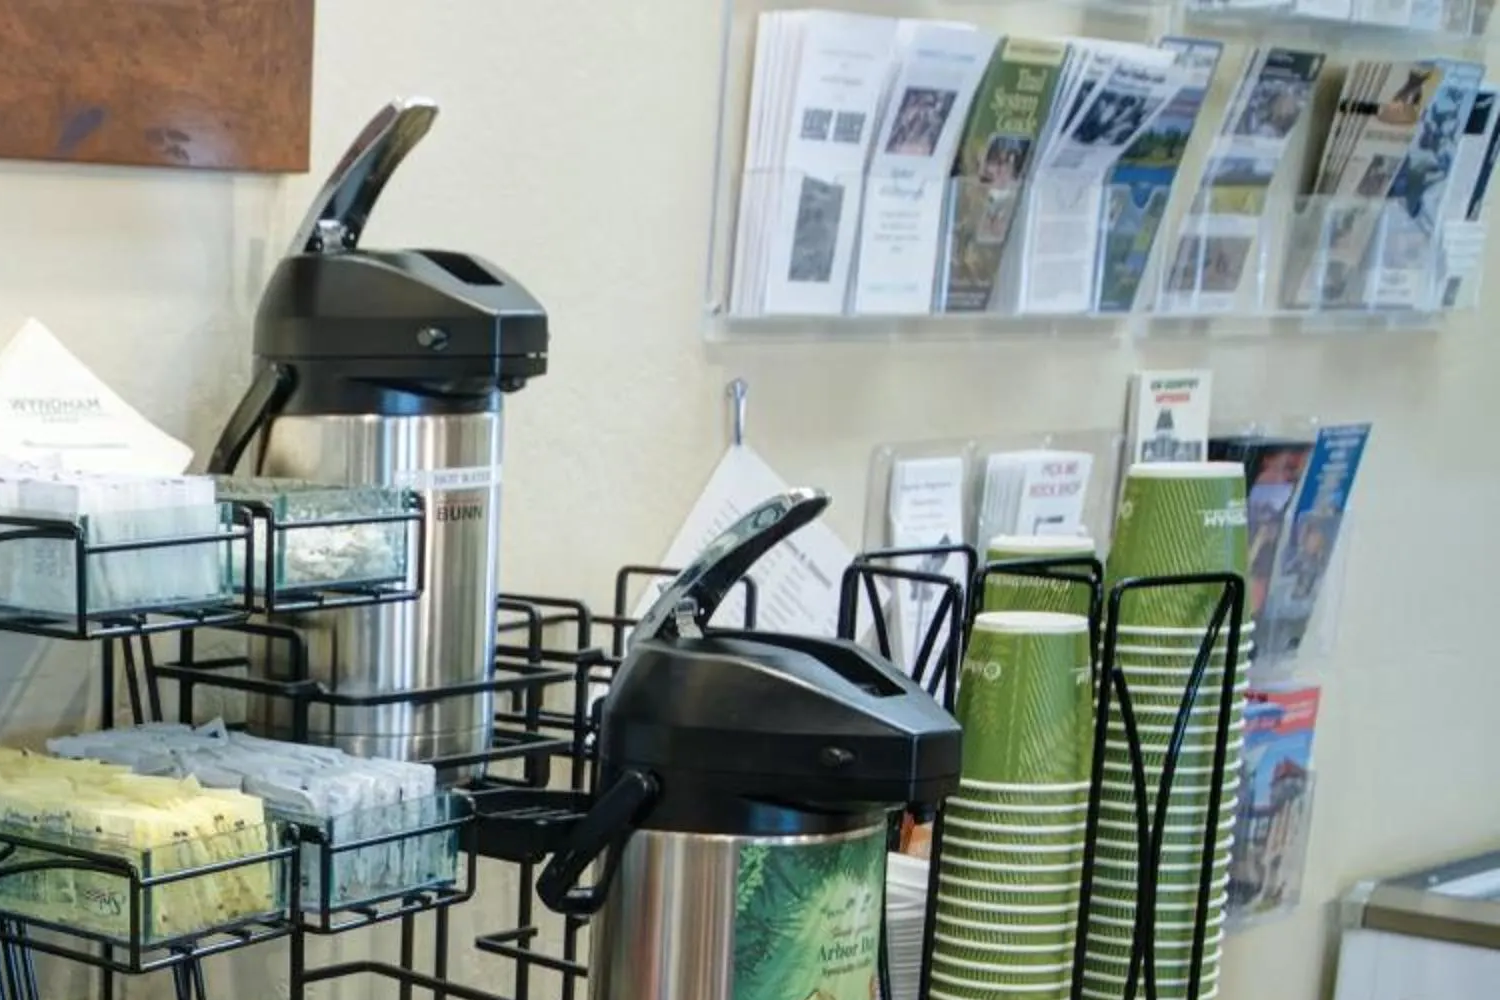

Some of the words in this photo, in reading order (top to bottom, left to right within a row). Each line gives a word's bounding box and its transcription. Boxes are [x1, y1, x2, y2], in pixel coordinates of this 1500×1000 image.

[8, 397, 102, 412] WYNDHAM
[435, 505, 484, 522] BUNN
[818, 939, 859, 962] Arbor
